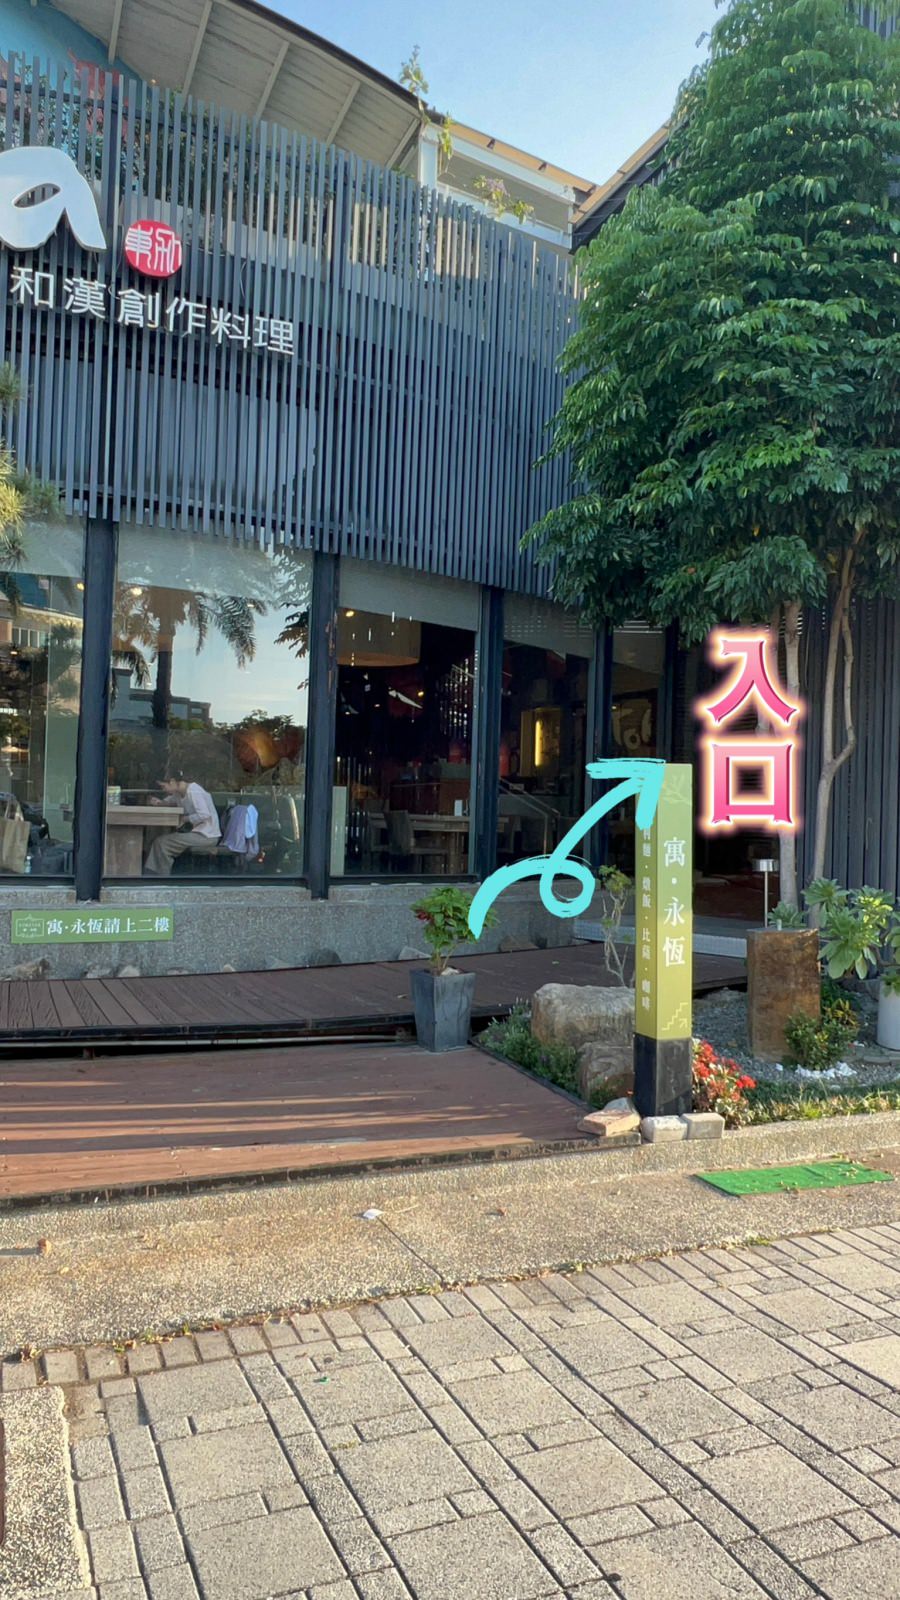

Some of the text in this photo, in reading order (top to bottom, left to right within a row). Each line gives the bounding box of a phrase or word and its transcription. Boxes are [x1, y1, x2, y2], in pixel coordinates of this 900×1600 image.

[10, 266, 295, 355] 和漢創作料理
